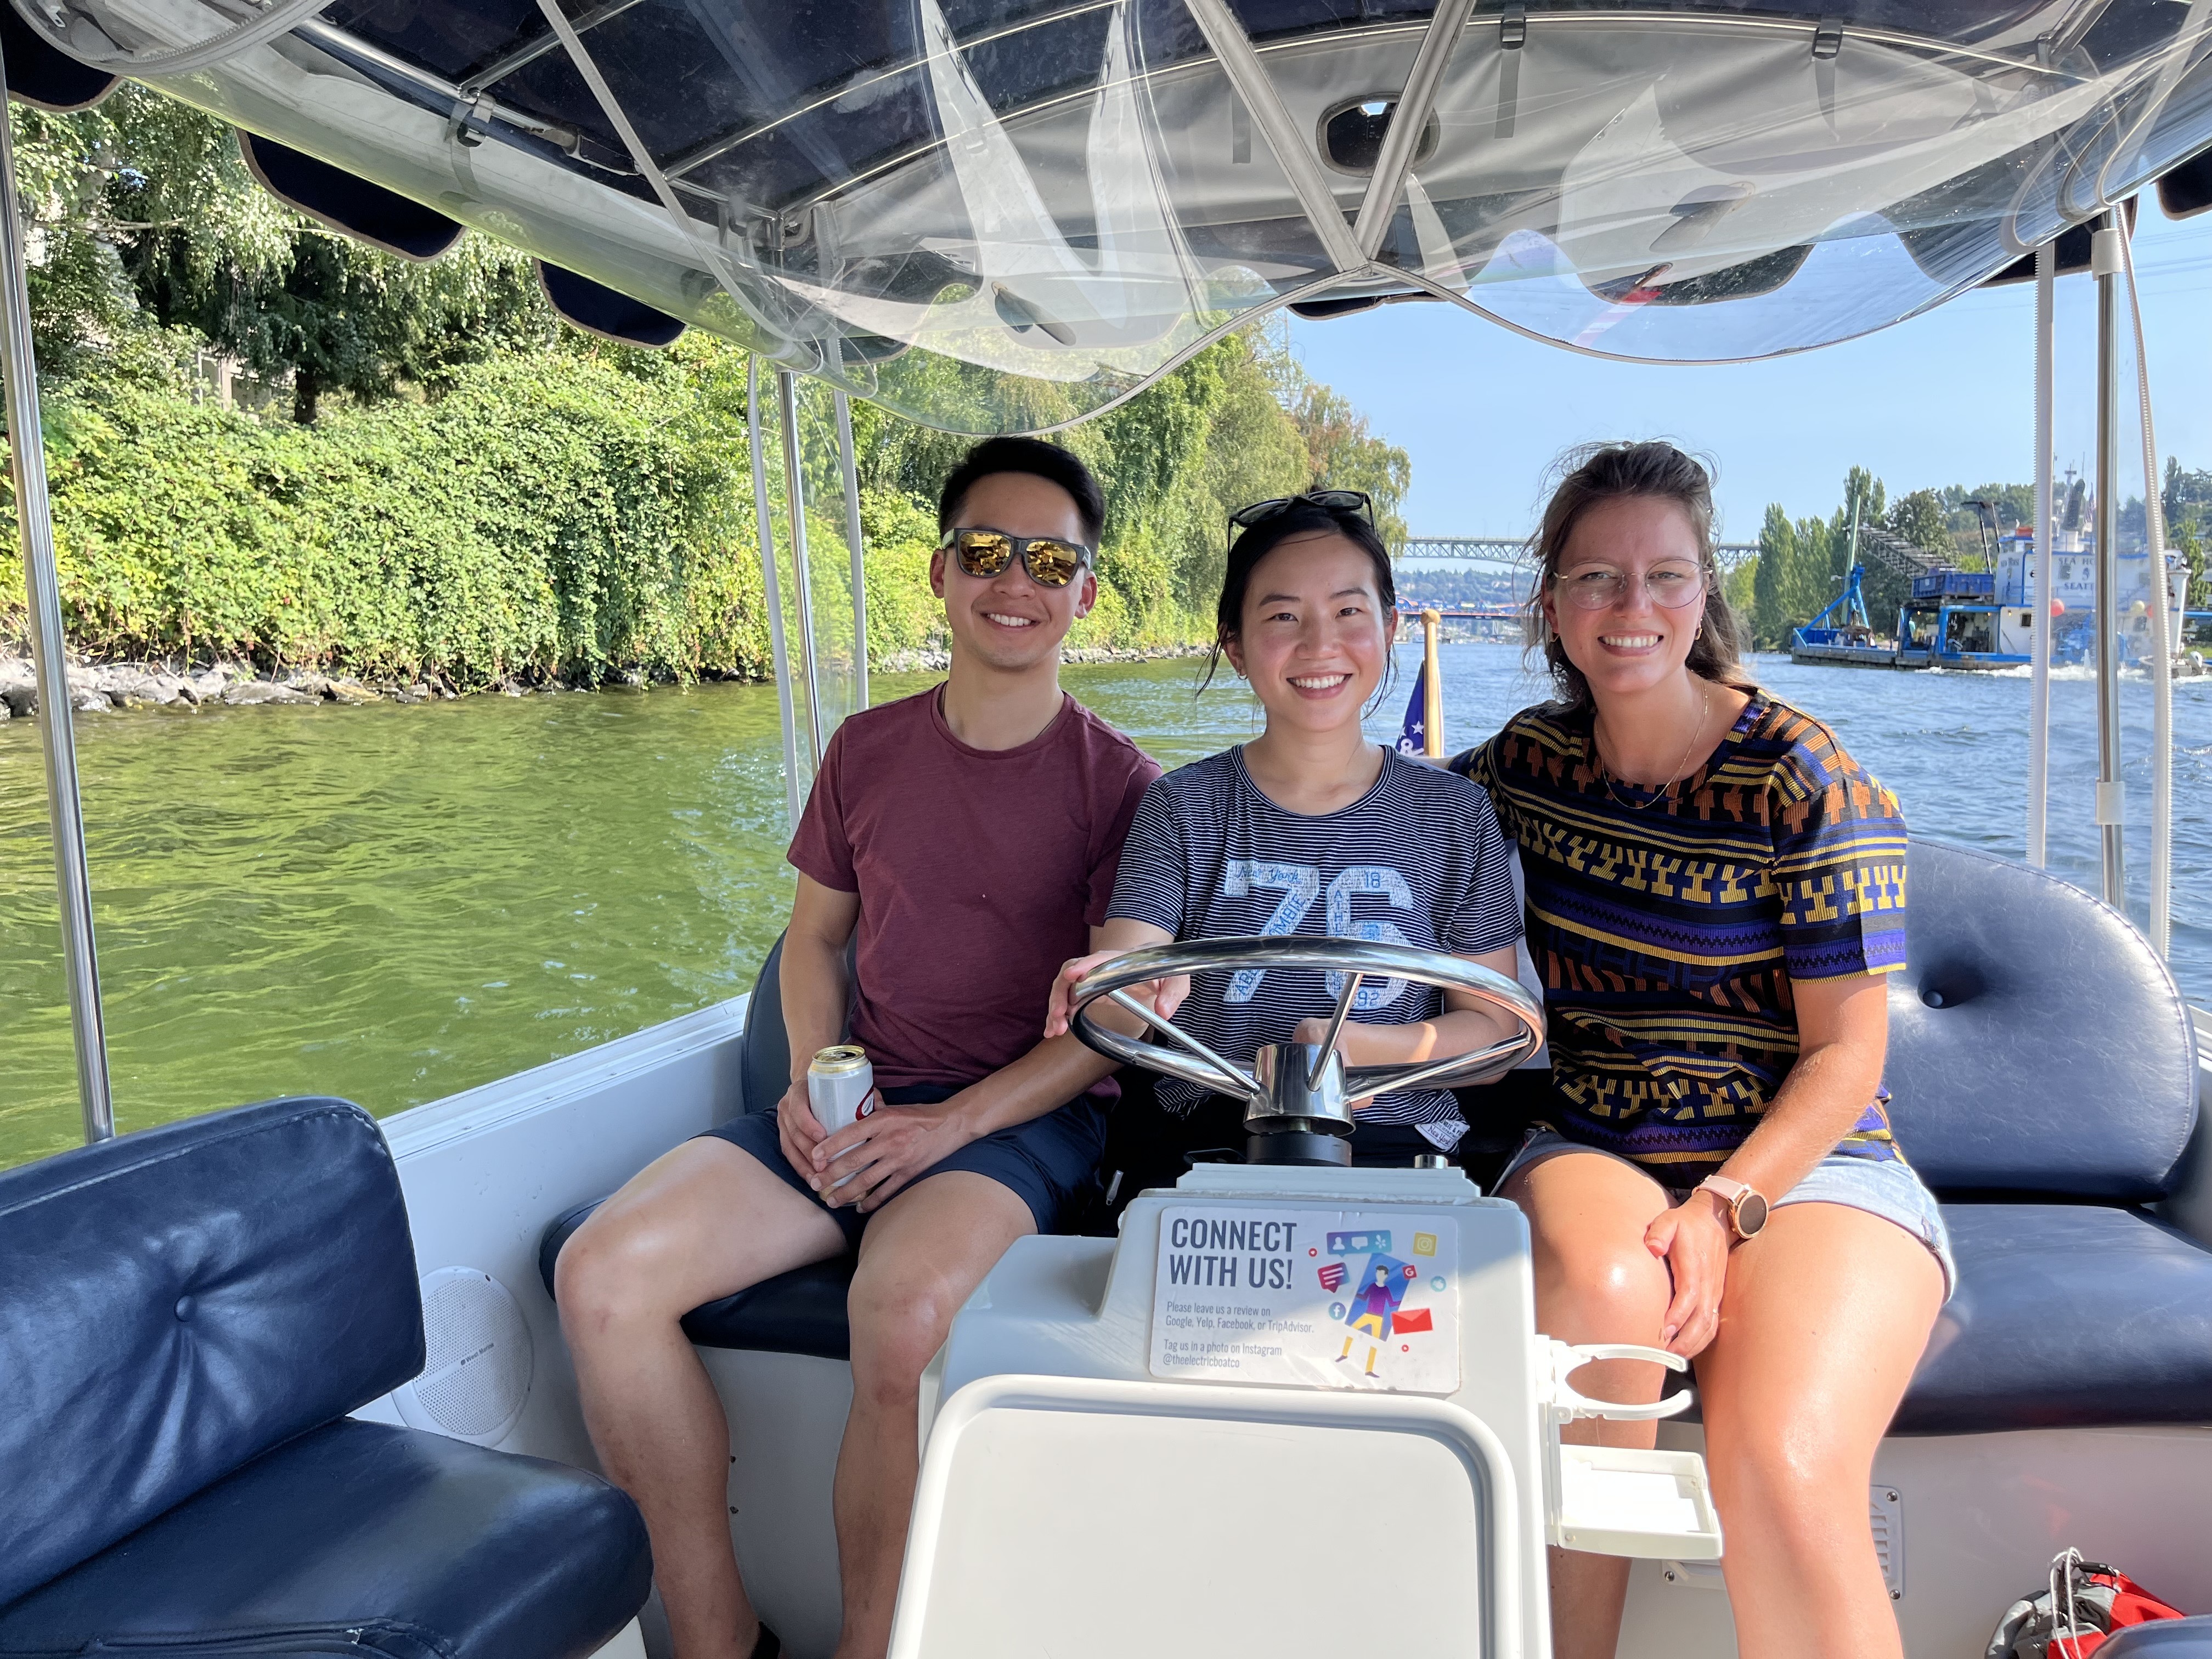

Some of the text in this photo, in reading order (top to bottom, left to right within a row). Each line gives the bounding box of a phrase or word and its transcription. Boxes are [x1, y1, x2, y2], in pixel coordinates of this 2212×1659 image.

[1268, 867, 1301, 884] York
[1364, 872, 1380, 888] 18
[1427, 1125, 1452, 1145] New York
[1171, 1218, 1297, 1252] CONNECT
[1170, 1254, 1293, 1290] WITH US!
[1167, 1301, 1271, 1317] Please leave us a review on
[1166, 1315, 1314, 1334] Google, Yelp, Facebook, or TripAdvisor.
[1164, 1339, 1282, 1357] Tag us in a photo on Instagram
[1163, 1353, 1240, 1368] @theelectricboatco
